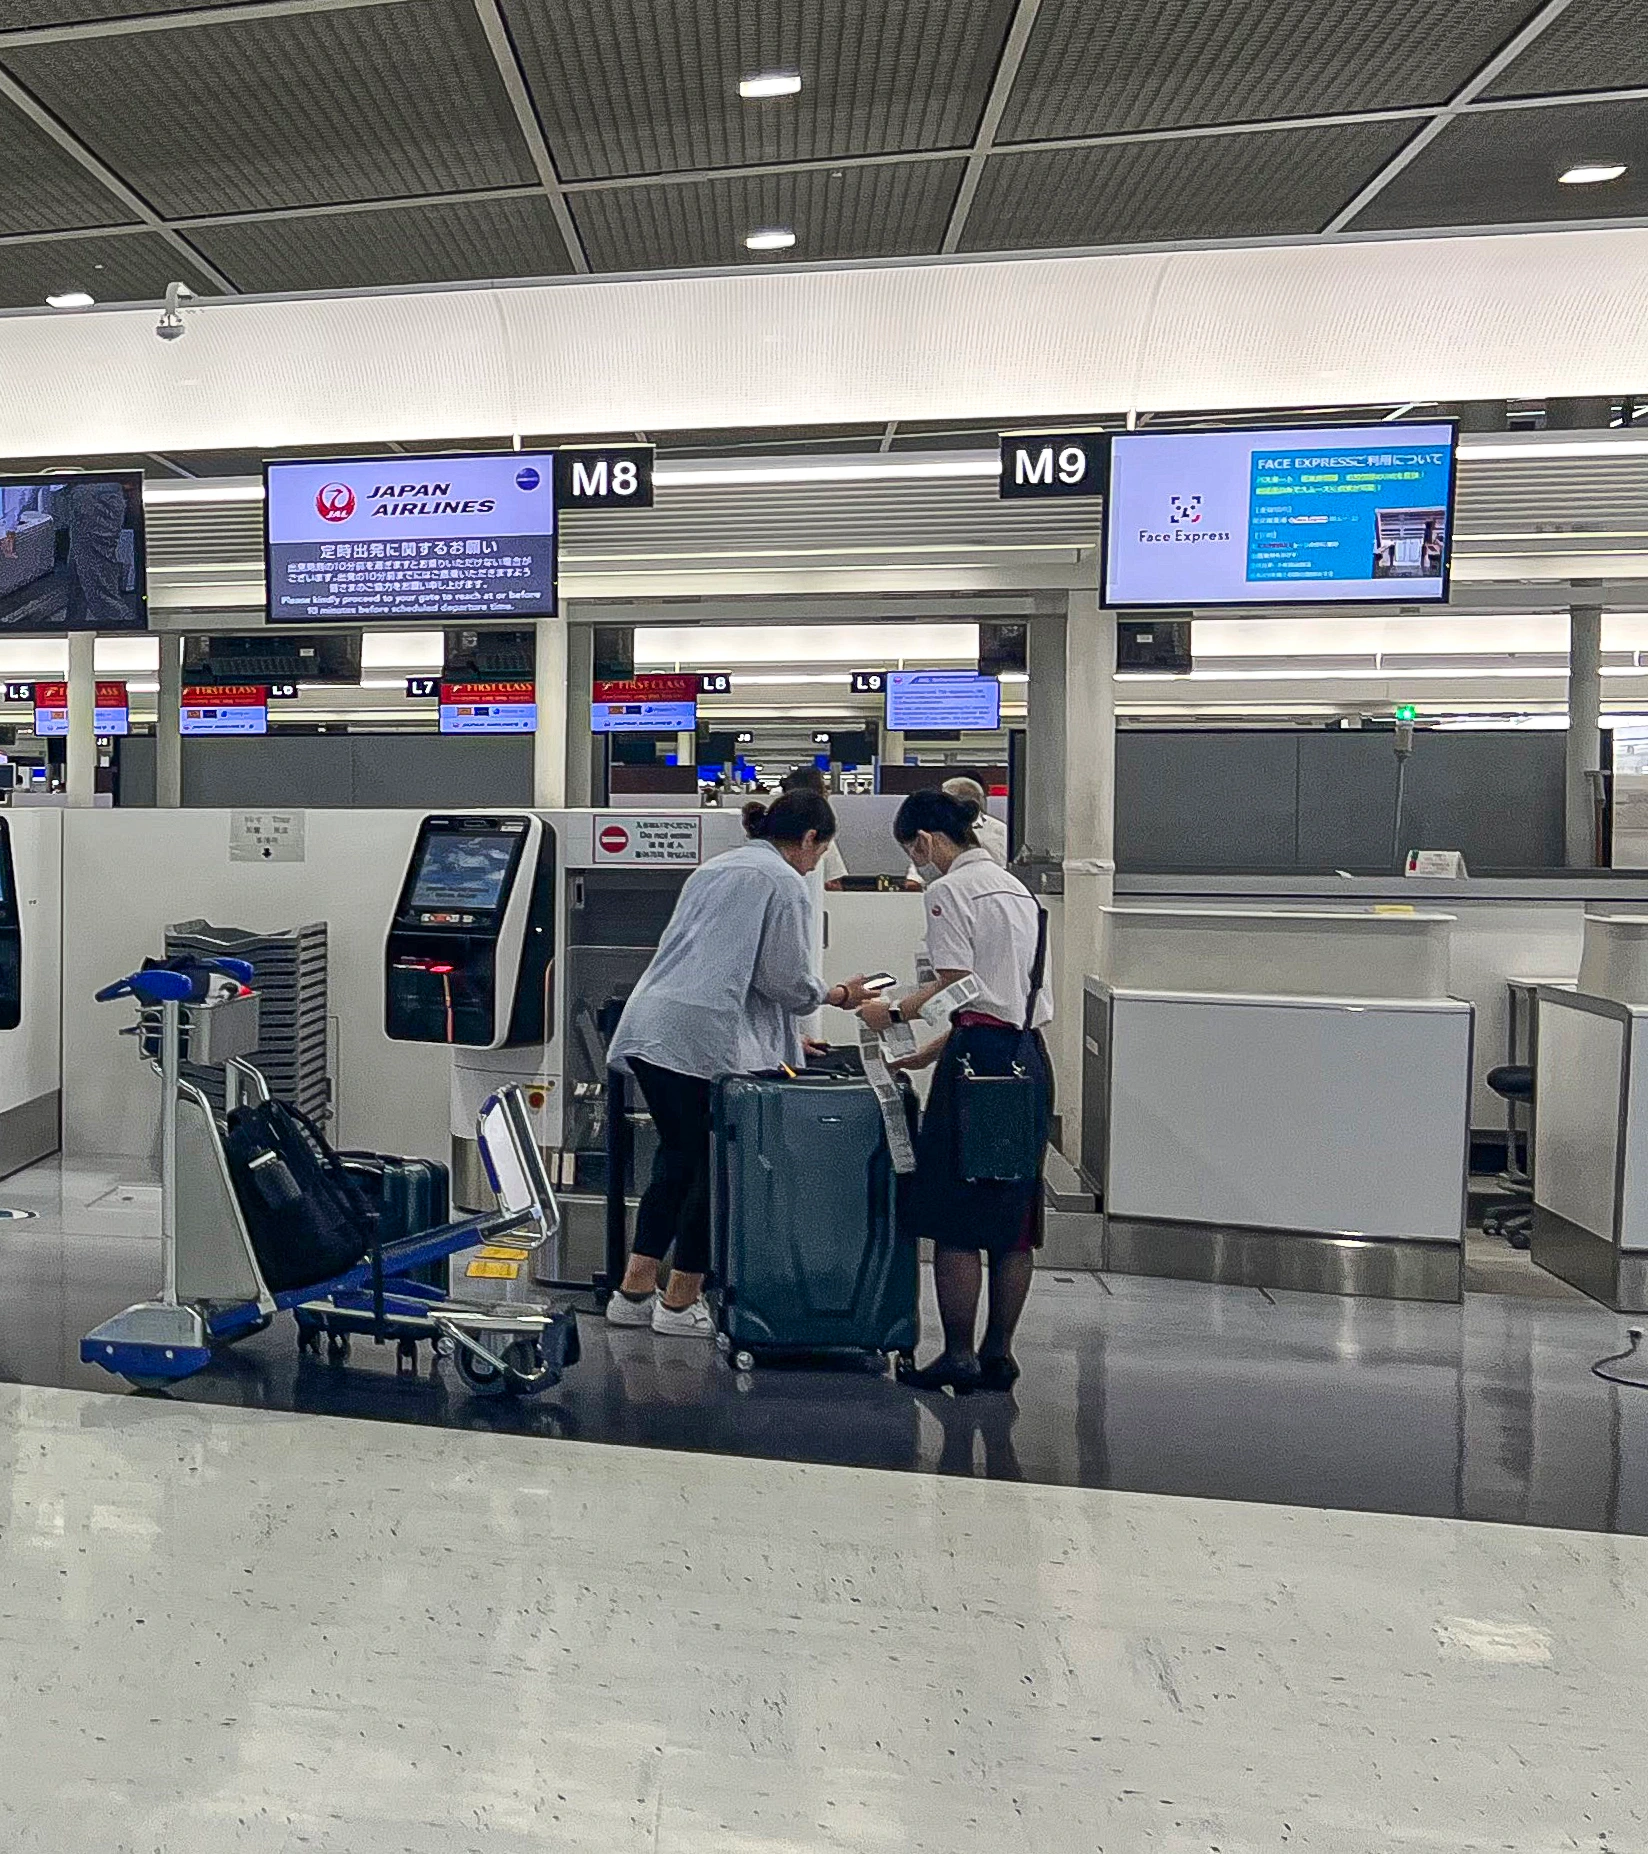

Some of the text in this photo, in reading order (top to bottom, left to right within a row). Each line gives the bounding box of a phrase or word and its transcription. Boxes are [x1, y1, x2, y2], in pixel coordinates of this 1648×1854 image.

[1015, 449, 1086, 484] M9
[1258, 459, 1291, 469] FACE
[572, 461, 638, 496] M8
[367, 482, 451, 499] JAPAN
[326, 510, 348, 519] JAL
[371, 500, 495, 517] AIRLINES
[1139, 529, 1230, 545] Face Express
[320, 540, 498, 559] 定時出発に関するお願い
[281, 596, 311, 605] Please
[312, 594, 340, 606] kindly
[341, 594, 381, 605] proceed
[382, 595, 393, 603] to
[395, 595, 416, 605] your
[418, 594, 440, 604] gate
[442, 593, 452, 601] to
[508, 590, 542, 599] before
[358, 604, 390, 614] before
[412, 680, 434, 694] L7
[703, 676, 727, 690] L8
[856, 675, 881, 690] L9
[9, 685, 30, 699] L5
